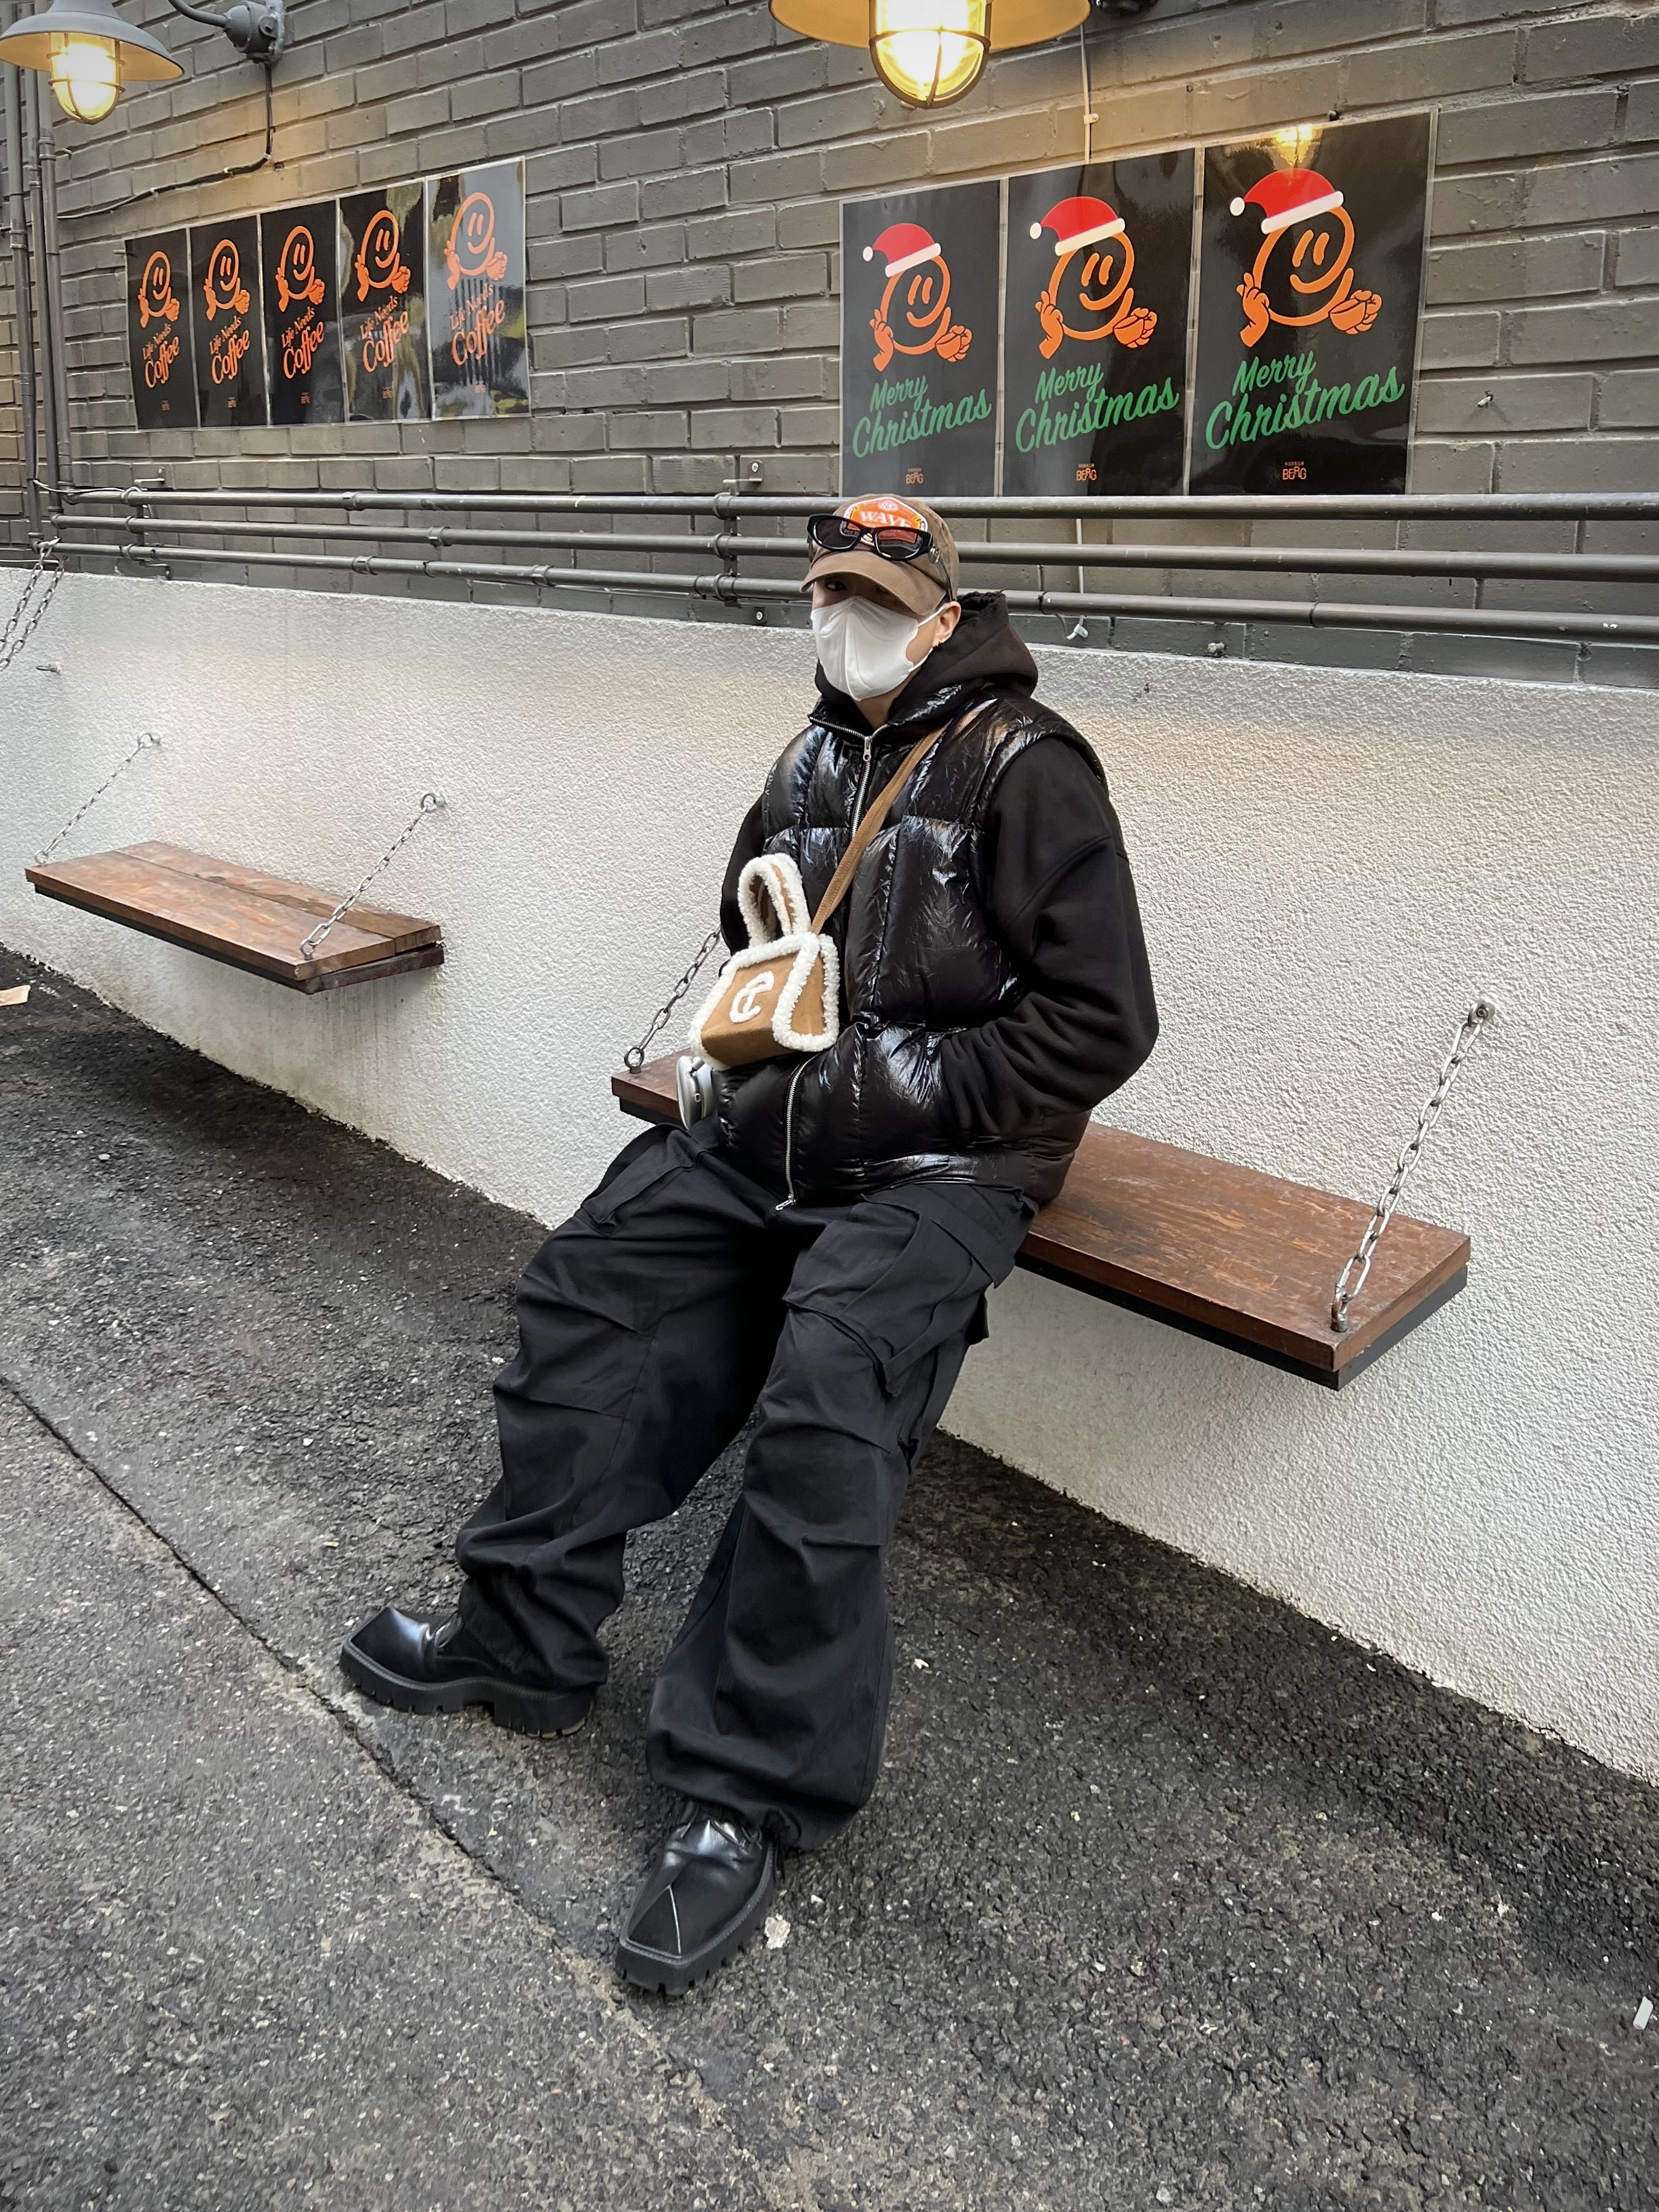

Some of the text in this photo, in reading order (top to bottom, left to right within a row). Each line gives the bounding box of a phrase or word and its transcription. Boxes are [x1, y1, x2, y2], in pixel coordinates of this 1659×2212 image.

[281, 306, 315, 348] Life Needs
[283, 322, 323, 378] Coffee
[363, 312, 408, 372] Coffee
[452, 300, 505, 365] Coffee
[144, 337, 179, 388] Coffee
[211, 330, 249, 384] Coffee
[1232, 351, 1317, 396] Merry
[870, 375, 928, 413] Merry
[1035, 362, 1104, 404] Merry
[1205, 366, 1405, 450] Christmas
[852, 389, 992, 458] Christmas
[1015, 377, 1180, 453] Christmas
[906, 472, 923, 484] BERG
[1076, 468, 1097, 481] BERG
[1282, 466, 1307, 481] BERG
